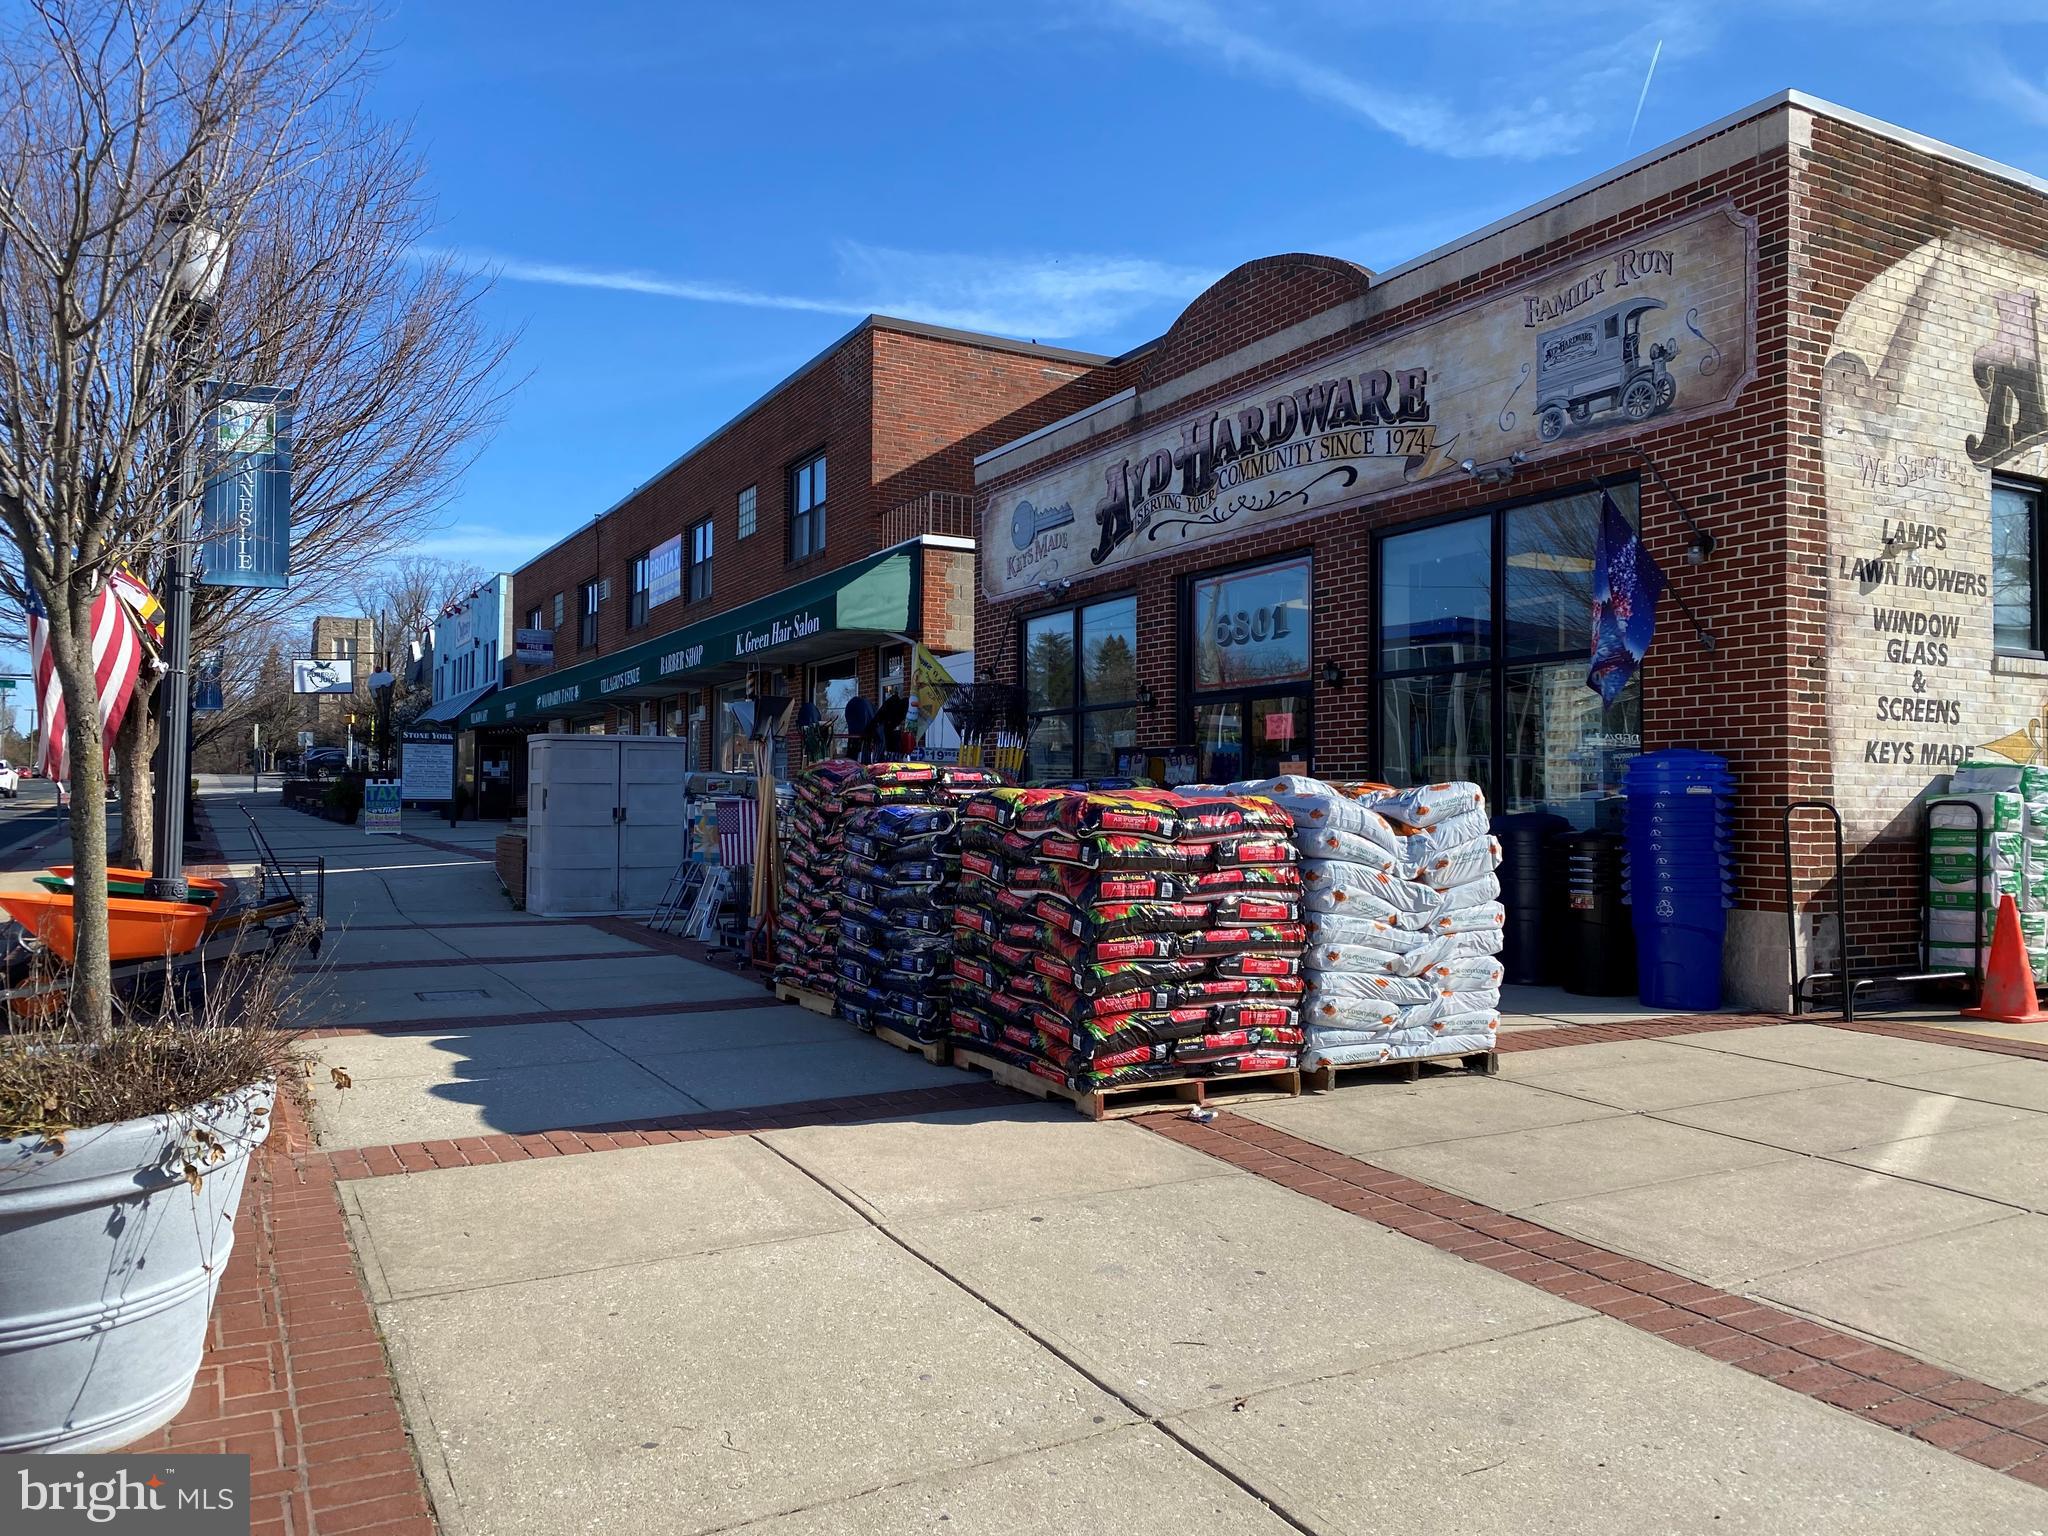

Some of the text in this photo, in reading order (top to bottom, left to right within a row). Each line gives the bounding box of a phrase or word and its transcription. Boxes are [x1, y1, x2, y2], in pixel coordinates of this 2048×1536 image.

[1522, 248, 1674, 328] FAMILY RUN
[1090, 367, 1431, 565] AYD HARDWARE
[1135, 428, 1427, 523] SERVING YOUR COMMUNITY SINCE 1974
[238, 457, 253, 570] ANNESLIE
[1882, 519, 1947, 550] LAMPS
[650, 546, 680, 582] PROTAX
[1005, 531, 1069, 580] KEYS MADE
[1839, 556, 1987, 597] LAWN MOWERS
[745, 631, 769, 653] Green
[771, 620, 792, 646] Hair
[794, 611, 820, 639] Salon
[1215, 605, 1291, 648] 6801
[1873, 608, 1960, 640] WINDOW
[660, 645, 704, 675] BARBER SHOP
[1886, 639, 1949, 667] GLASS
[1911, 670, 1926, 694] &
[1876, 696, 1961, 726] SCREENS
[402, 731, 453, 740] STONE YORK
[1865, 740, 1975, 766] KEYS MADE
[367, 786, 399, 800] TAX
